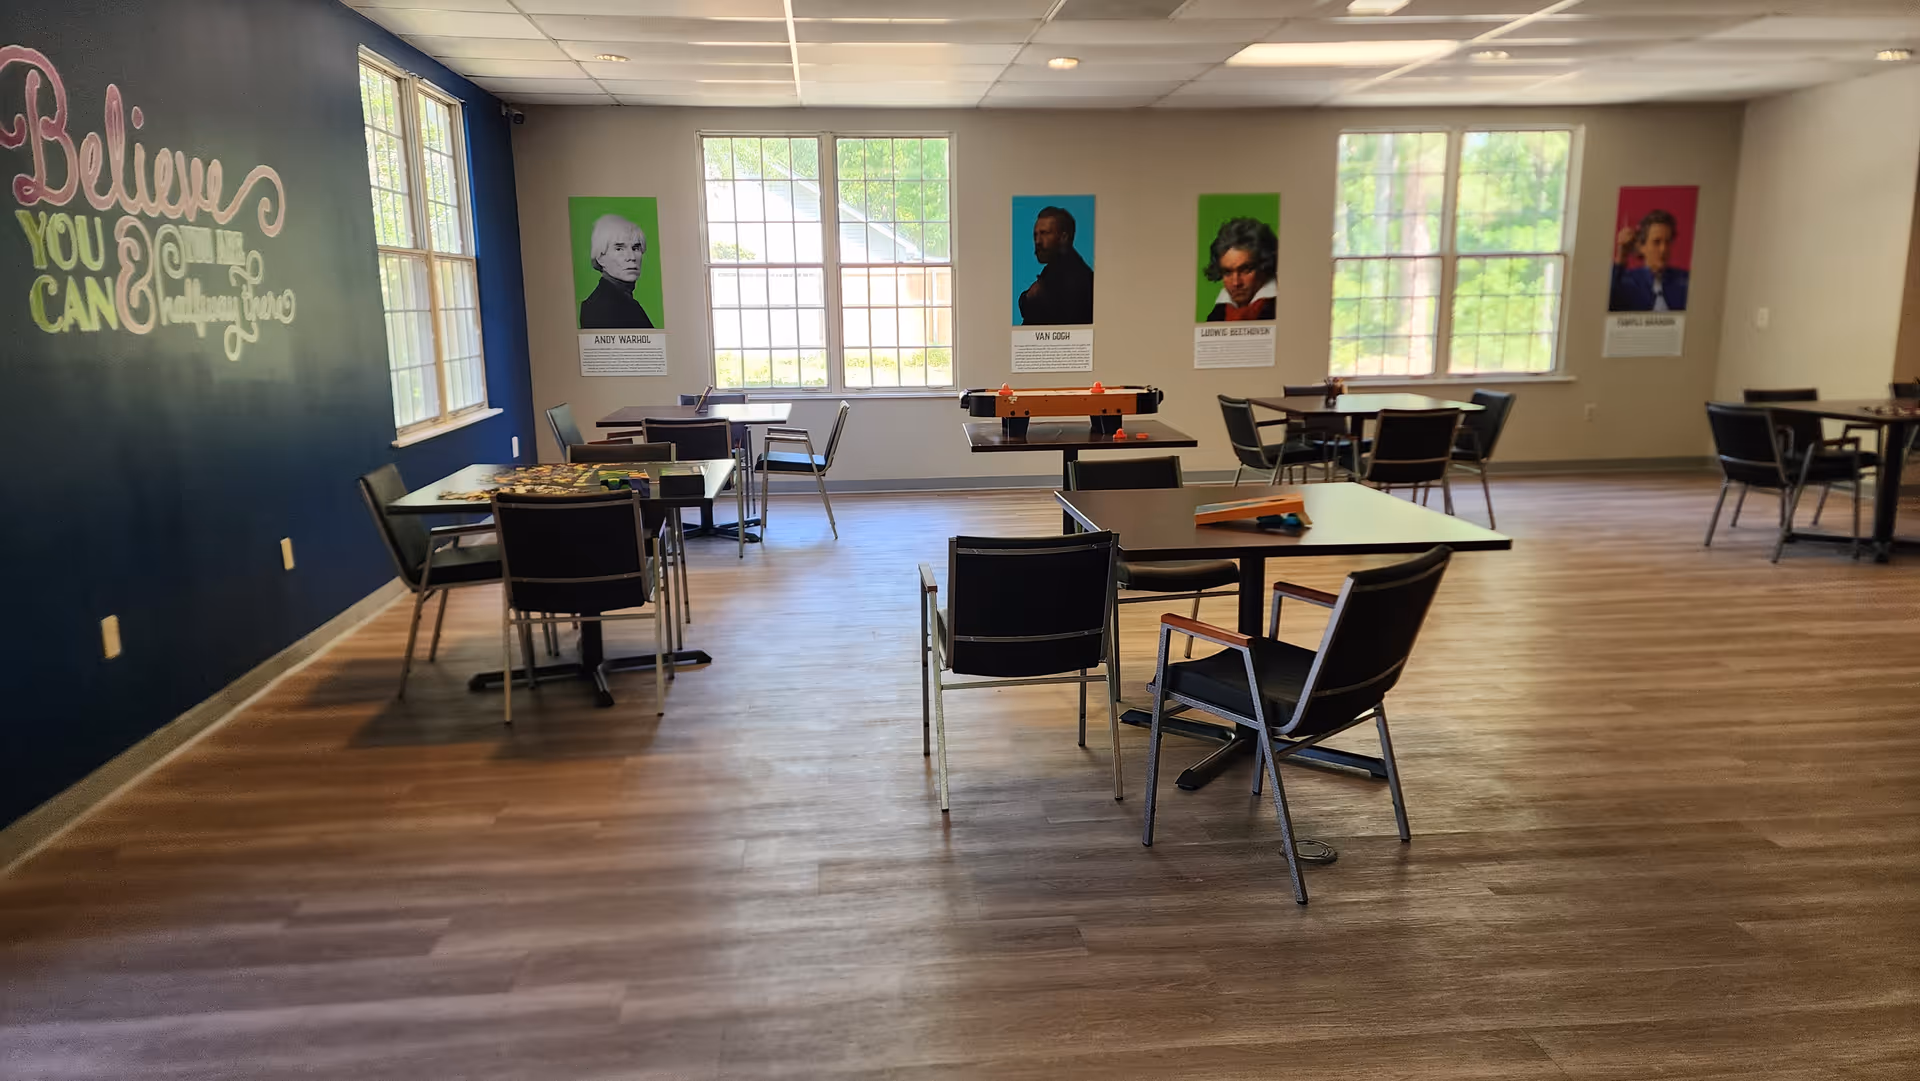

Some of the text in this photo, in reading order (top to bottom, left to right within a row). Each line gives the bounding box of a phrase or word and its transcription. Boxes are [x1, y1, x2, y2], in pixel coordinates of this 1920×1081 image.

[0, 45, 285, 237] Believe
[15, 209, 104, 271] YOU
[29, 274, 118, 333] CAN
[594, 335, 651, 344] ANDY WARHOL
[1035, 332, 1070, 340] VAN GOGH
